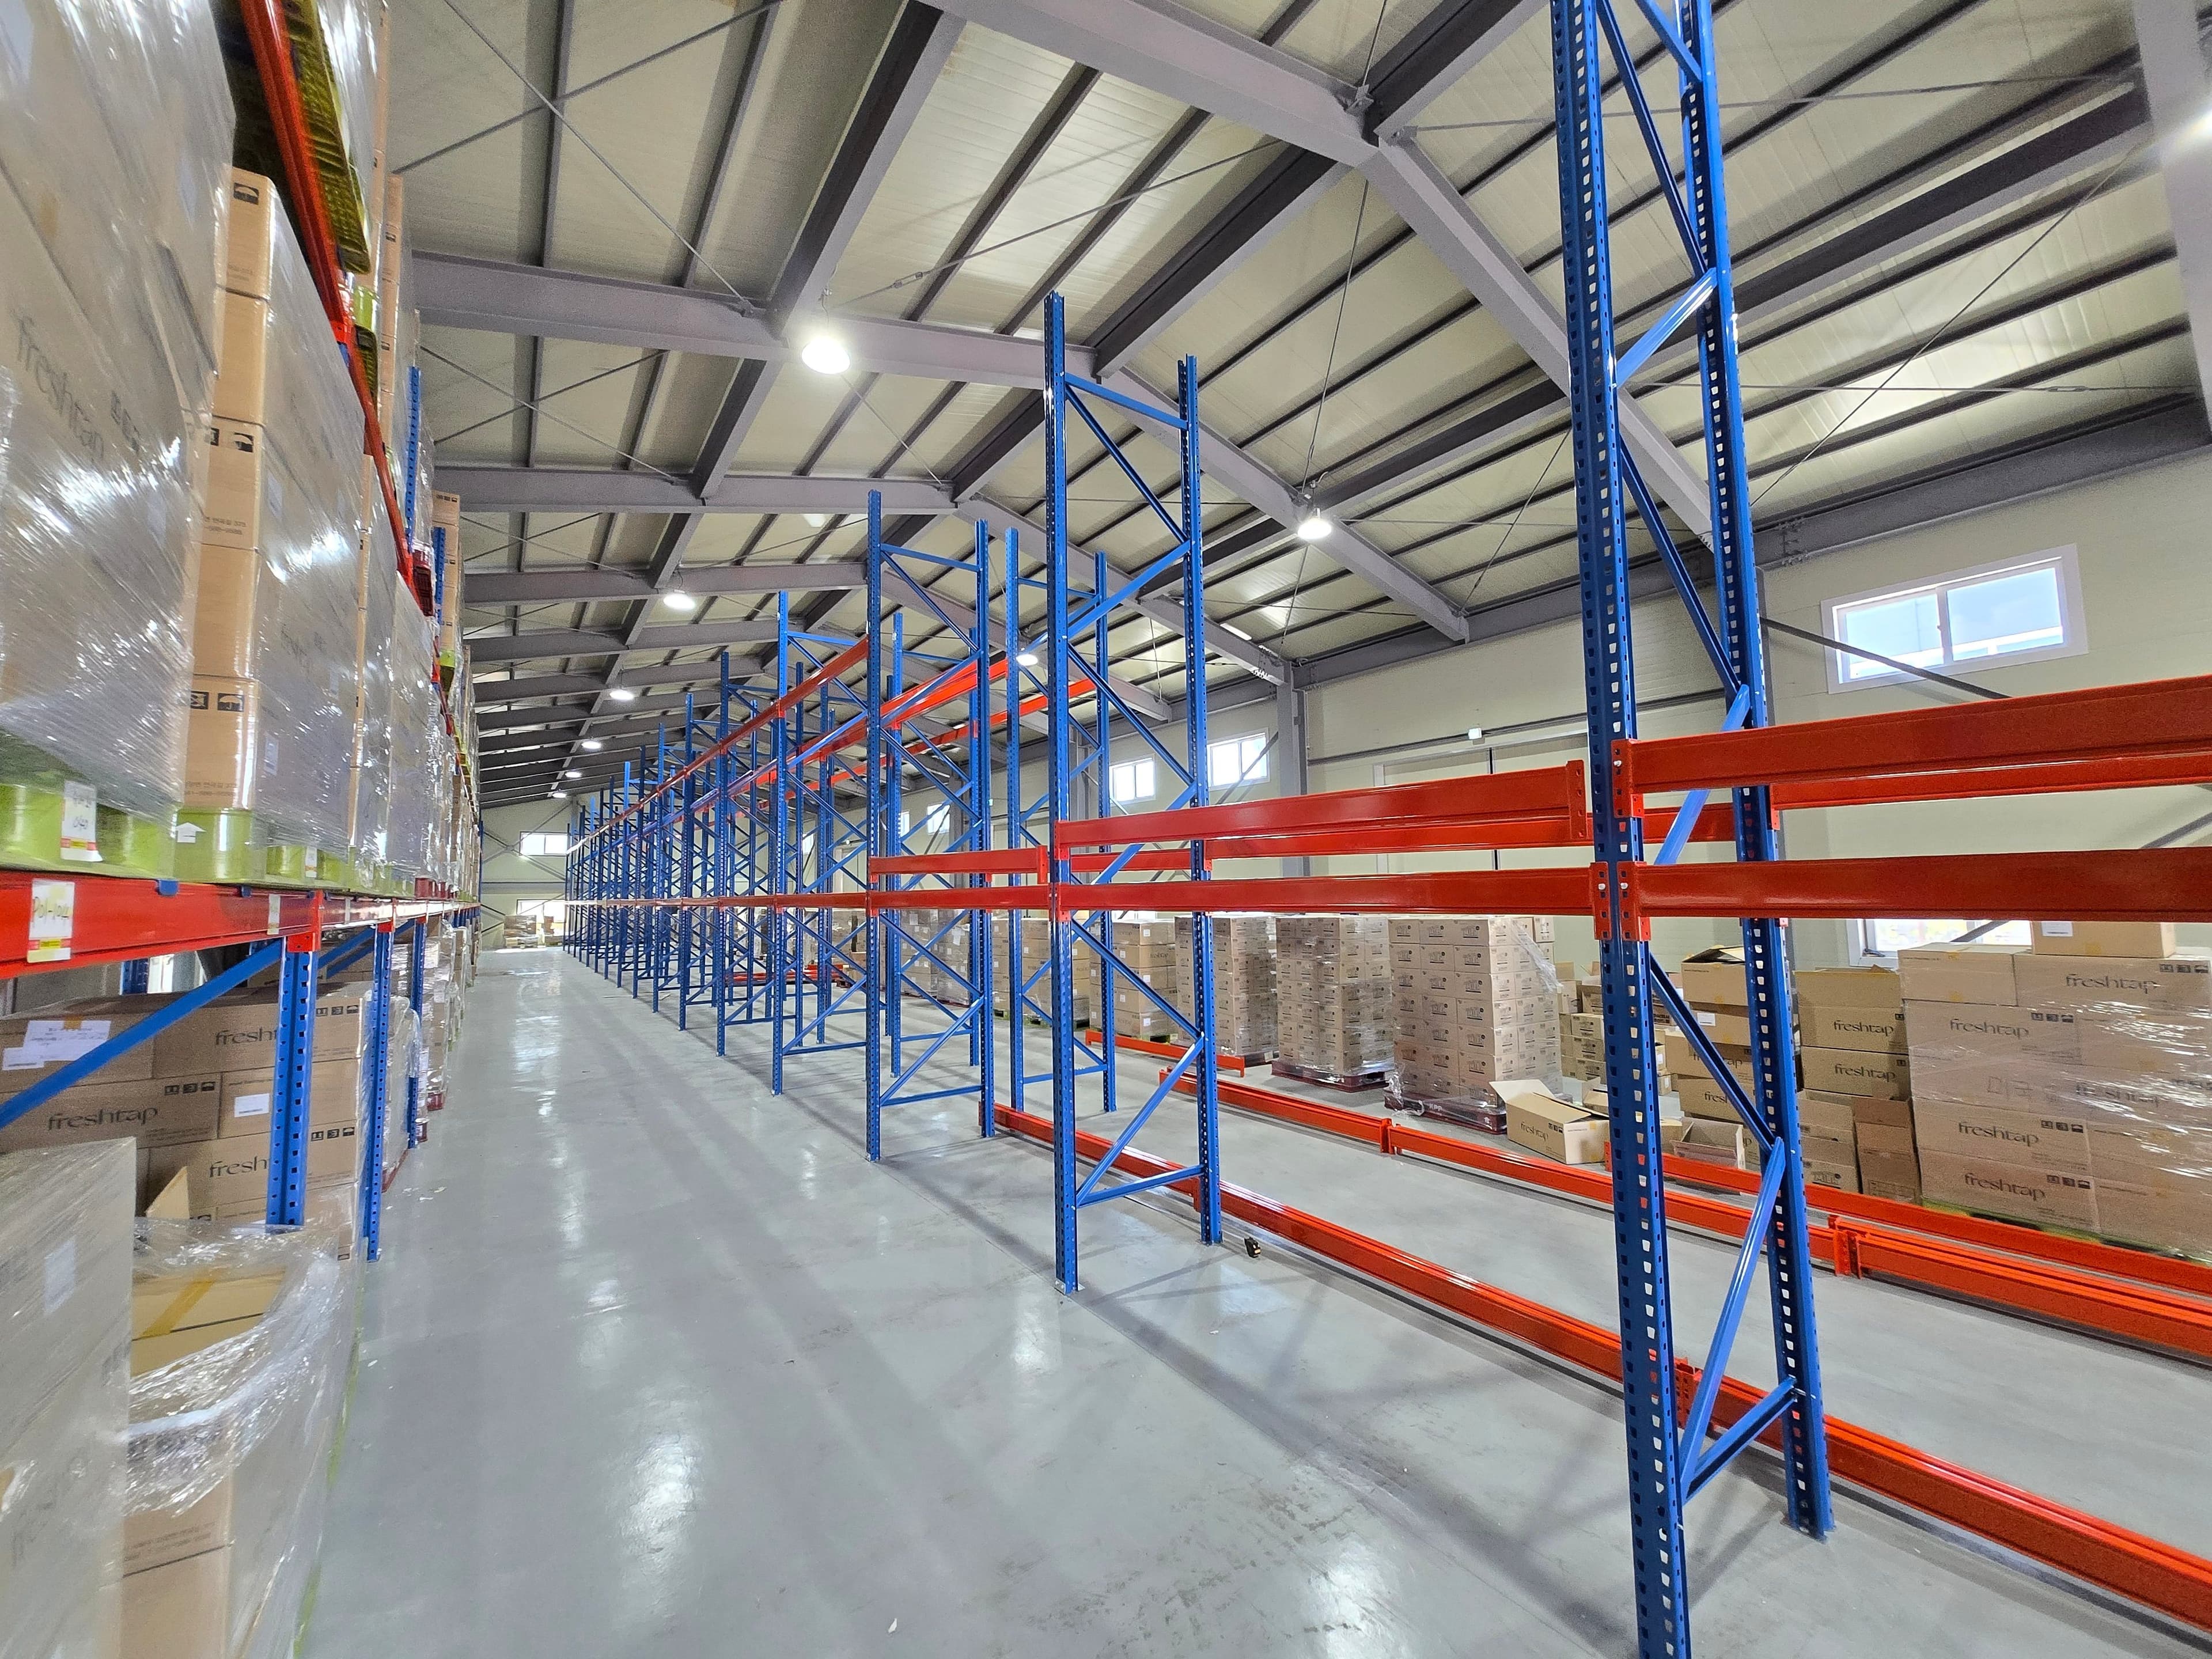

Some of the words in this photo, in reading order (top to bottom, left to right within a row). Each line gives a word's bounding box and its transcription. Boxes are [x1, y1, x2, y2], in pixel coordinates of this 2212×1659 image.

[2065, 974, 2161, 994] freshtap
[1834, 1020, 1894, 1036] freshtap
[1950, 1018, 2029, 1038] freshtap
[1834, 1063, 1896, 1082] freshtap
[48, 1107, 158, 1131] freshtap
[1521, 1121, 1549, 1142] freshtap
[1959, 1121, 2040, 1146] freshtap
[1964, 1172, 2046, 1201] freshtap
